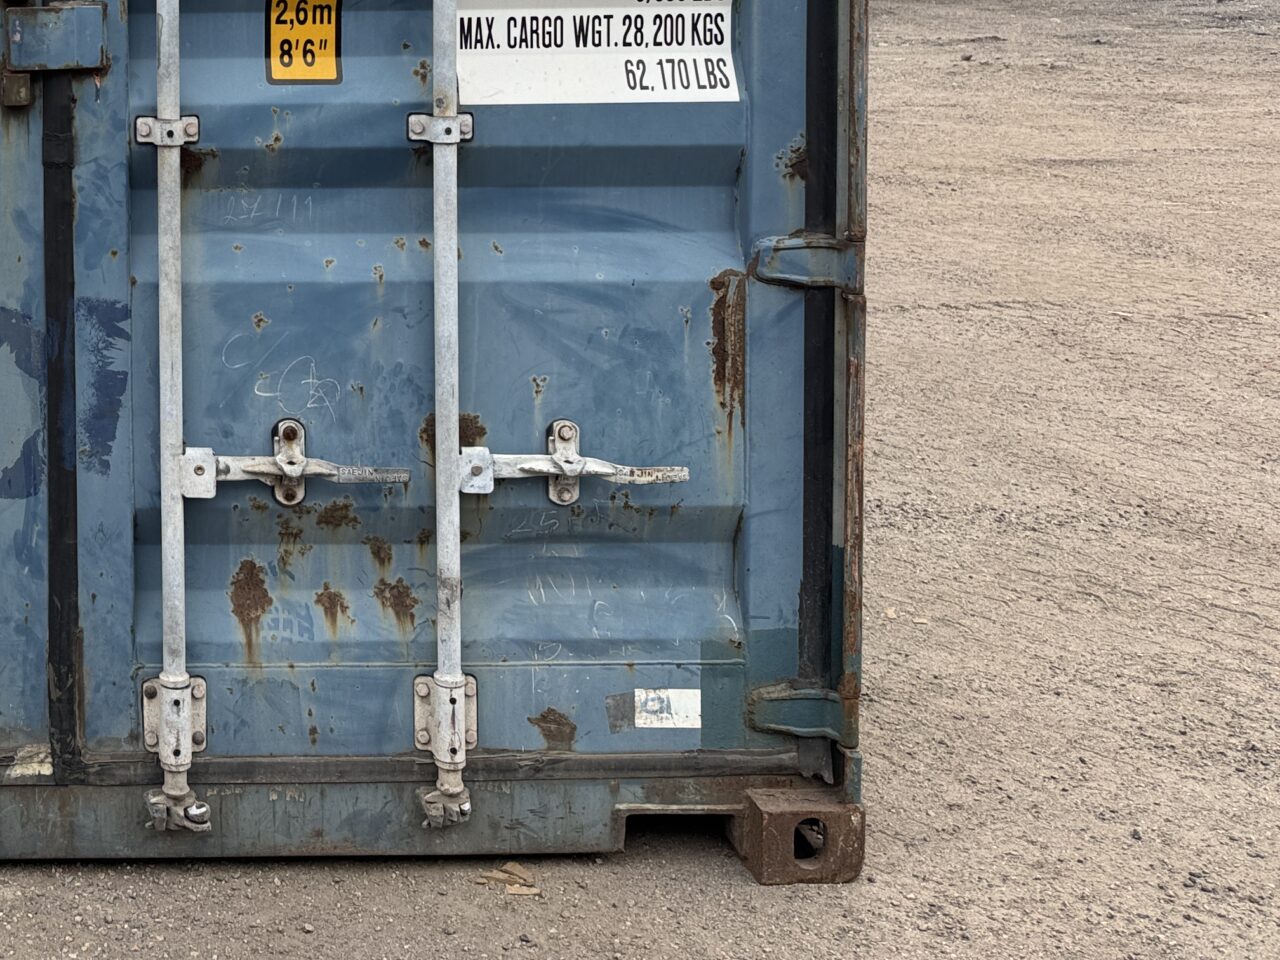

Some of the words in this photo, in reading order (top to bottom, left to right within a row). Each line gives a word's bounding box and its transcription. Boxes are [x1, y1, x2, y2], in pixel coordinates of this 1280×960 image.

[459, 16, 501, 50] MAX.
[506, 16, 564, 49] CARGO
[573, 15, 618, 48] WGT.
[622, 13, 686, 48] 28,200
[691, 13, 725, 46] KGS
[624, 58, 690, 92] 62,170
[694, 58, 731, 90] LBS
